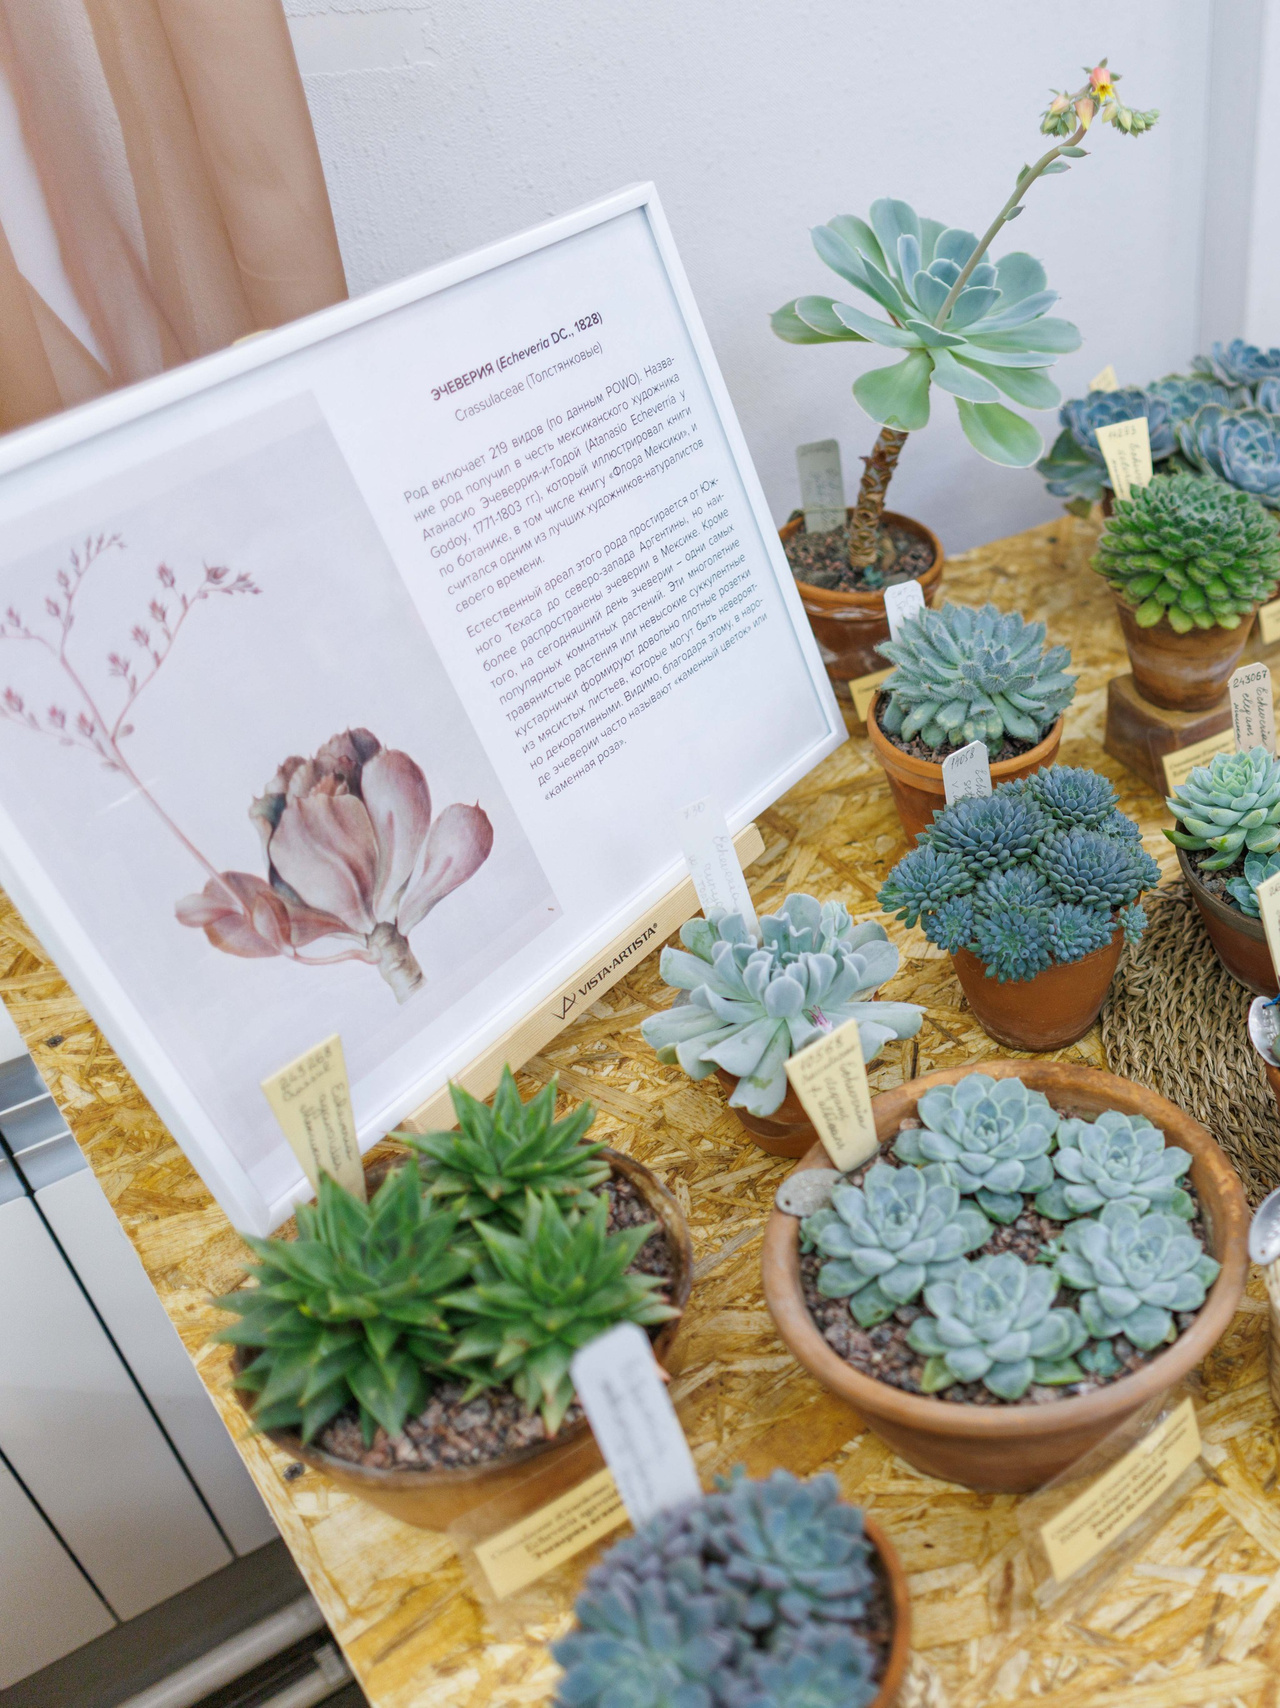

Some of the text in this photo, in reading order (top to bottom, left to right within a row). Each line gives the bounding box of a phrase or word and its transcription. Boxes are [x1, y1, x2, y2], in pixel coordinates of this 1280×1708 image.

[403, 356, 674, 503] Род включает 219 видов (по данным POWO). Назва-
[430, 311, 602, 401] ЭЧЕВЕРИЯ (Echeveria DC., 1828)
[454, 340, 602, 421] Crassulaceae (Толстянковые)
[413, 373, 680, 522] ние род получил в честь мексиканского художника
[422, 506, 475, 541] Атанасио
[479, 446, 581, 508] Эчеверрия-и-Годой
[584, 422, 627, 453] (Atanasio
[678, 389, 685, 401] y
[430, 406, 691, 558] Godoy, 1771-1803 гг.), который иллюстрировал книги
[438, 422, 697, 577] по ботанике, в том числе книгу «Флора Мексики», и
[447, 438, 703, 595] считался одним из лучших художников-натуралистов
[455, 555, 544, 612] своего времени.
[465, 477, 718, 638] Естественный ареал этого рода простирается от Юж-
[475, 493, 724, 655] ного Техаса до северо-запада Аргентины, но наи-
[482, 508, 728, 671] более распространены эчеверии в Мексике. Кроме
[489, 523, 734, 688] того, на сегодняшний день эчеверии одни самых
[498, 539, 740, 705] популярных комнатных растений. Эти многолетние
[505, 553, 745, 721] травянистые растения или невысокие суккулентные
[514, 568, 751, 737] кустарнички формируют довольно плотные розетки
[521, 740, 535, 753] из
[537, 704, 586, 742] мясистых
[587, 676, 628, 708] листьев,
[629, 647, 667, 678] которые
[669, 627, 693, 649] могут
[695, 613, 716, 630] быть
[529, 755, 543, 769] но
[545, 700, 623, 760] декоративными.
[623, 673, 662, 702] Видимо,
[662, 637, 707, 674] благодаря
[733, 614, 740, 622] в
[537, 771, 551, 787] де
[552, 736, 599, 774] эчеверии
[600, 716, 627, 737] часто
[627, 682, 672, 719] называют
[673, 646, 719, 685] «каменный
[752, 612, 767, 627] или
[544, 739, 626, 800] «каменная роза».
